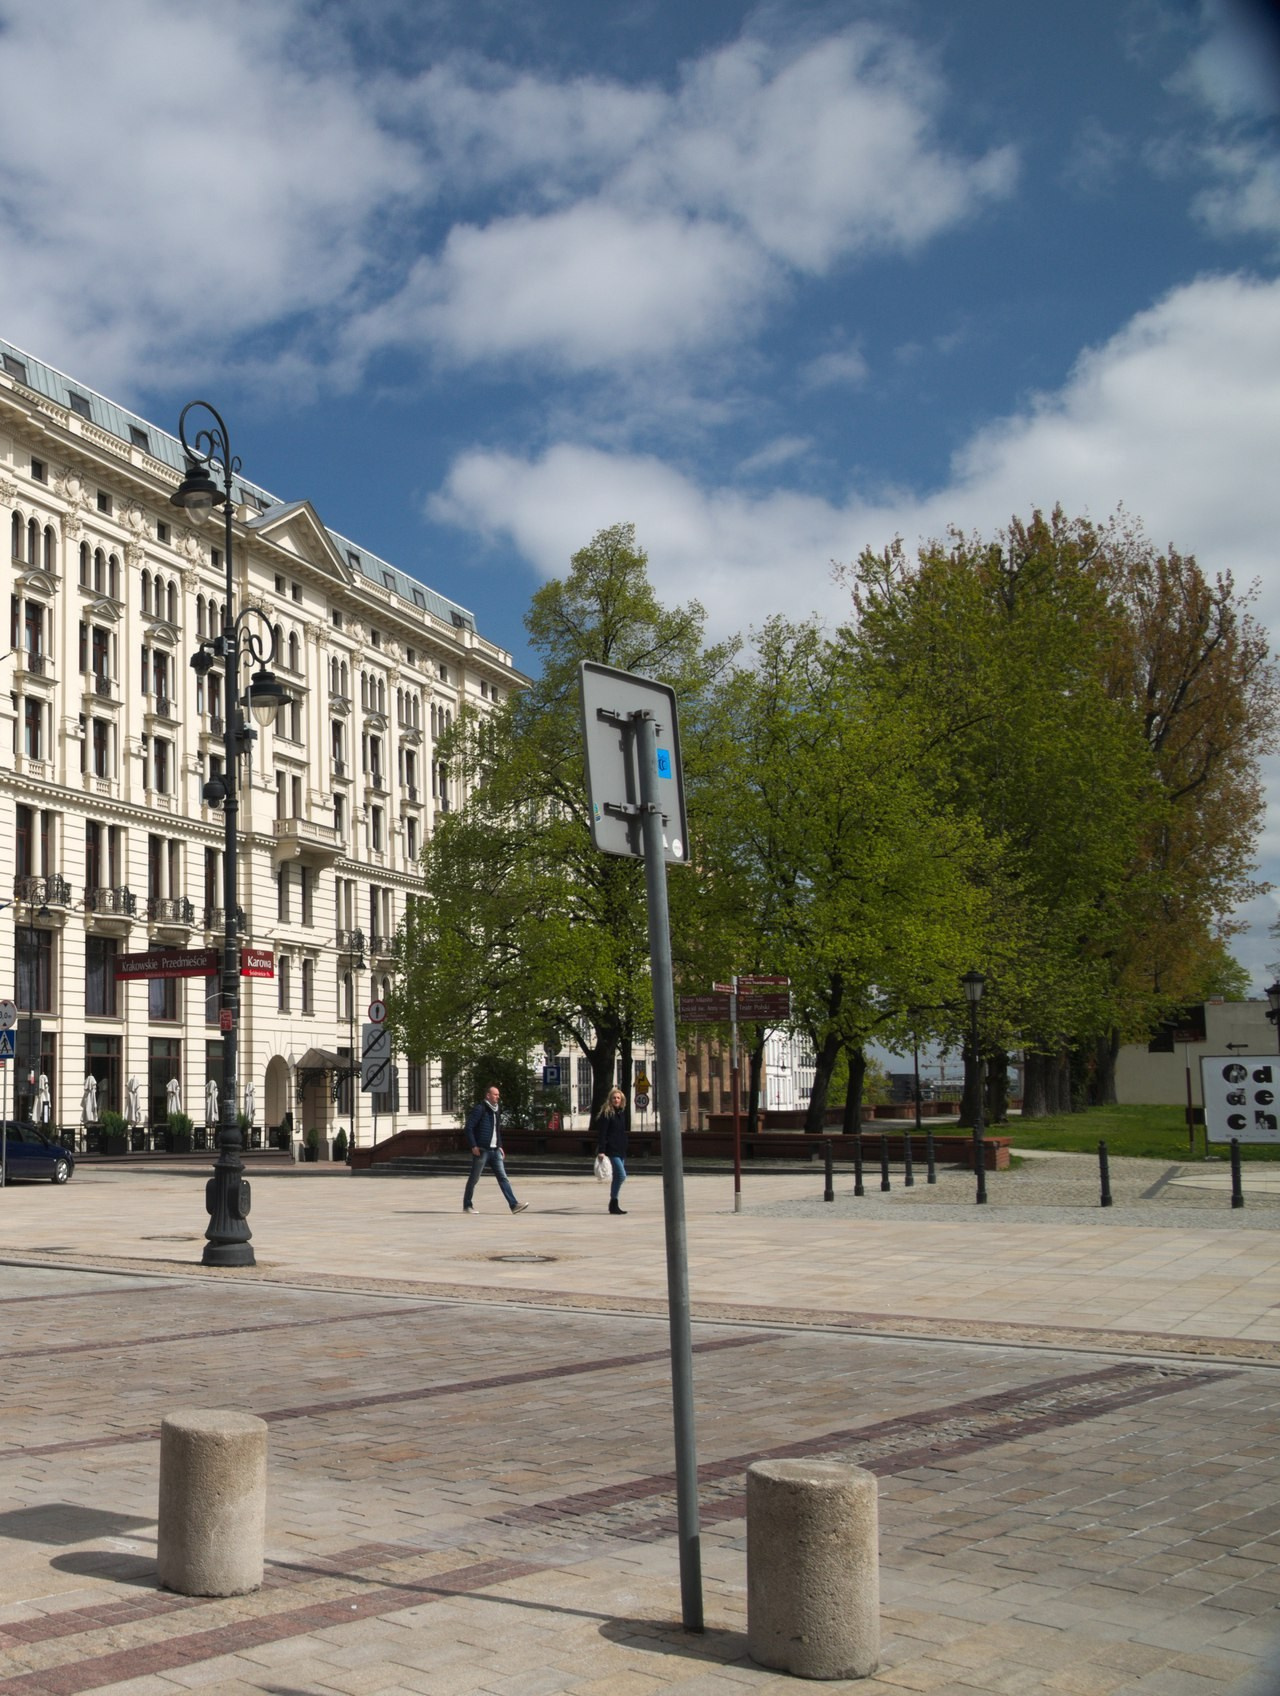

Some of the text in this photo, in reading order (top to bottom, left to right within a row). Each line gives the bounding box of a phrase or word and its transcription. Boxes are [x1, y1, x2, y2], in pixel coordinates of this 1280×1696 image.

[121, 954, 207, 972] Krakowskie Przedmieście
[247, 955, 272, 968] Karowa
[546, 1068, 557, 1083] P
[636, 1096, 647, 1105] 40
